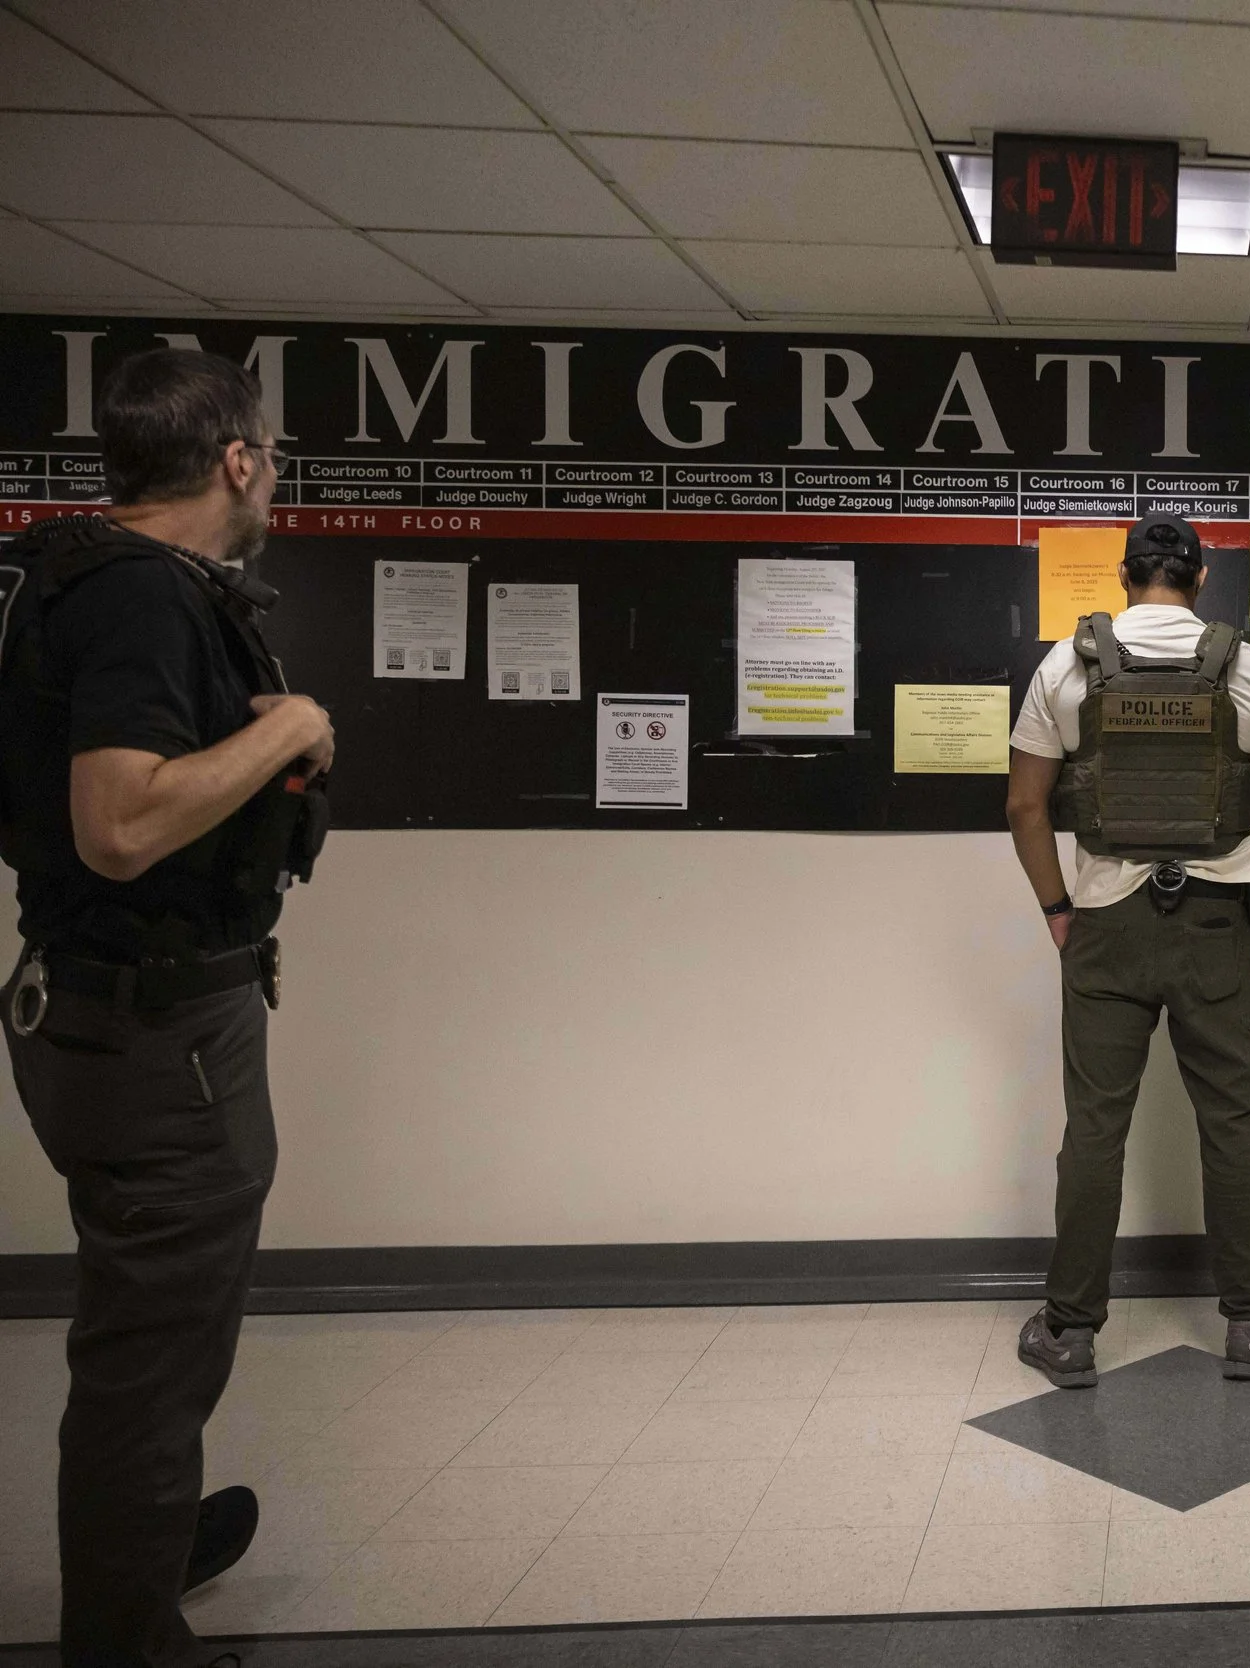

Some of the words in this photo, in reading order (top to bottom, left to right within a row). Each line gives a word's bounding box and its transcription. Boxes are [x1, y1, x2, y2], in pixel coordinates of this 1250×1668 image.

[1026, 149, 1149, 247] EXIT
[24, 459, 32, 471] 7
[62, 460, 104, 473] Court
[310, 464, 388, 477] Courtroom
[395, 466, 411, 478] 10
[435, 466, 513, 479] Courtroom
[520, 468, 531, 479] 11
[556, 468, 632, 481] Courtroom
[639, 470, 653, 481] 12
[676, 471, 752, 483] Courtroom
[758, 472, 773, 483] 13
[795, 472, 870, 485] Courtroom
[877, 474, 891, 485] 14
[69, 481, 99, 492] Judge
[913, 474, 987, 487] Courtroom
[994, 476, 1008, 487] 15
[1030, 477, 1103, 489] Courtroom
[1110, 478, 1125, 490] 16
[1146, 479, 1219, 491] Courtroom
[1226, 480, 1239, 491] 17
[320, 487, 360, 501] Judge
[364, 488, 401, 499] Leeds
[436, 491, 475, 504] Judge
[480, 491, 527, 505] Douchy
[563, 492, 602, 506] Judge
[605, 492, 646, 506] Wright
[673, 493, 711, 507] Judge
[715, 493, 727, 504] C.
[732, 494, 777, 505] Gordon
[797, 495, 835, 509] Judge
[839, 496, 892, 509] Zagzoug
[905, 496, 934, 510] Judge
[937, 496, 1015, 509] Johnson-Papillo
[1024, 499, 1056, 512] Judge
[1059, 499, 1132, 511] Siemietkowski
[1149, 500, 1190, 515] Judge
[1195, 501, 1237, 512] Kouris
[267, 514, 298, 528] HE
[320, 515, 376, 528] 14TH
[402, 516, 481, 530] FLOOR
[1122, 701, 1193, 716] POLICE
[1109, 718, 1157, 726] FEDERAL
[1161, 718, 1205, 726] OFFICER
